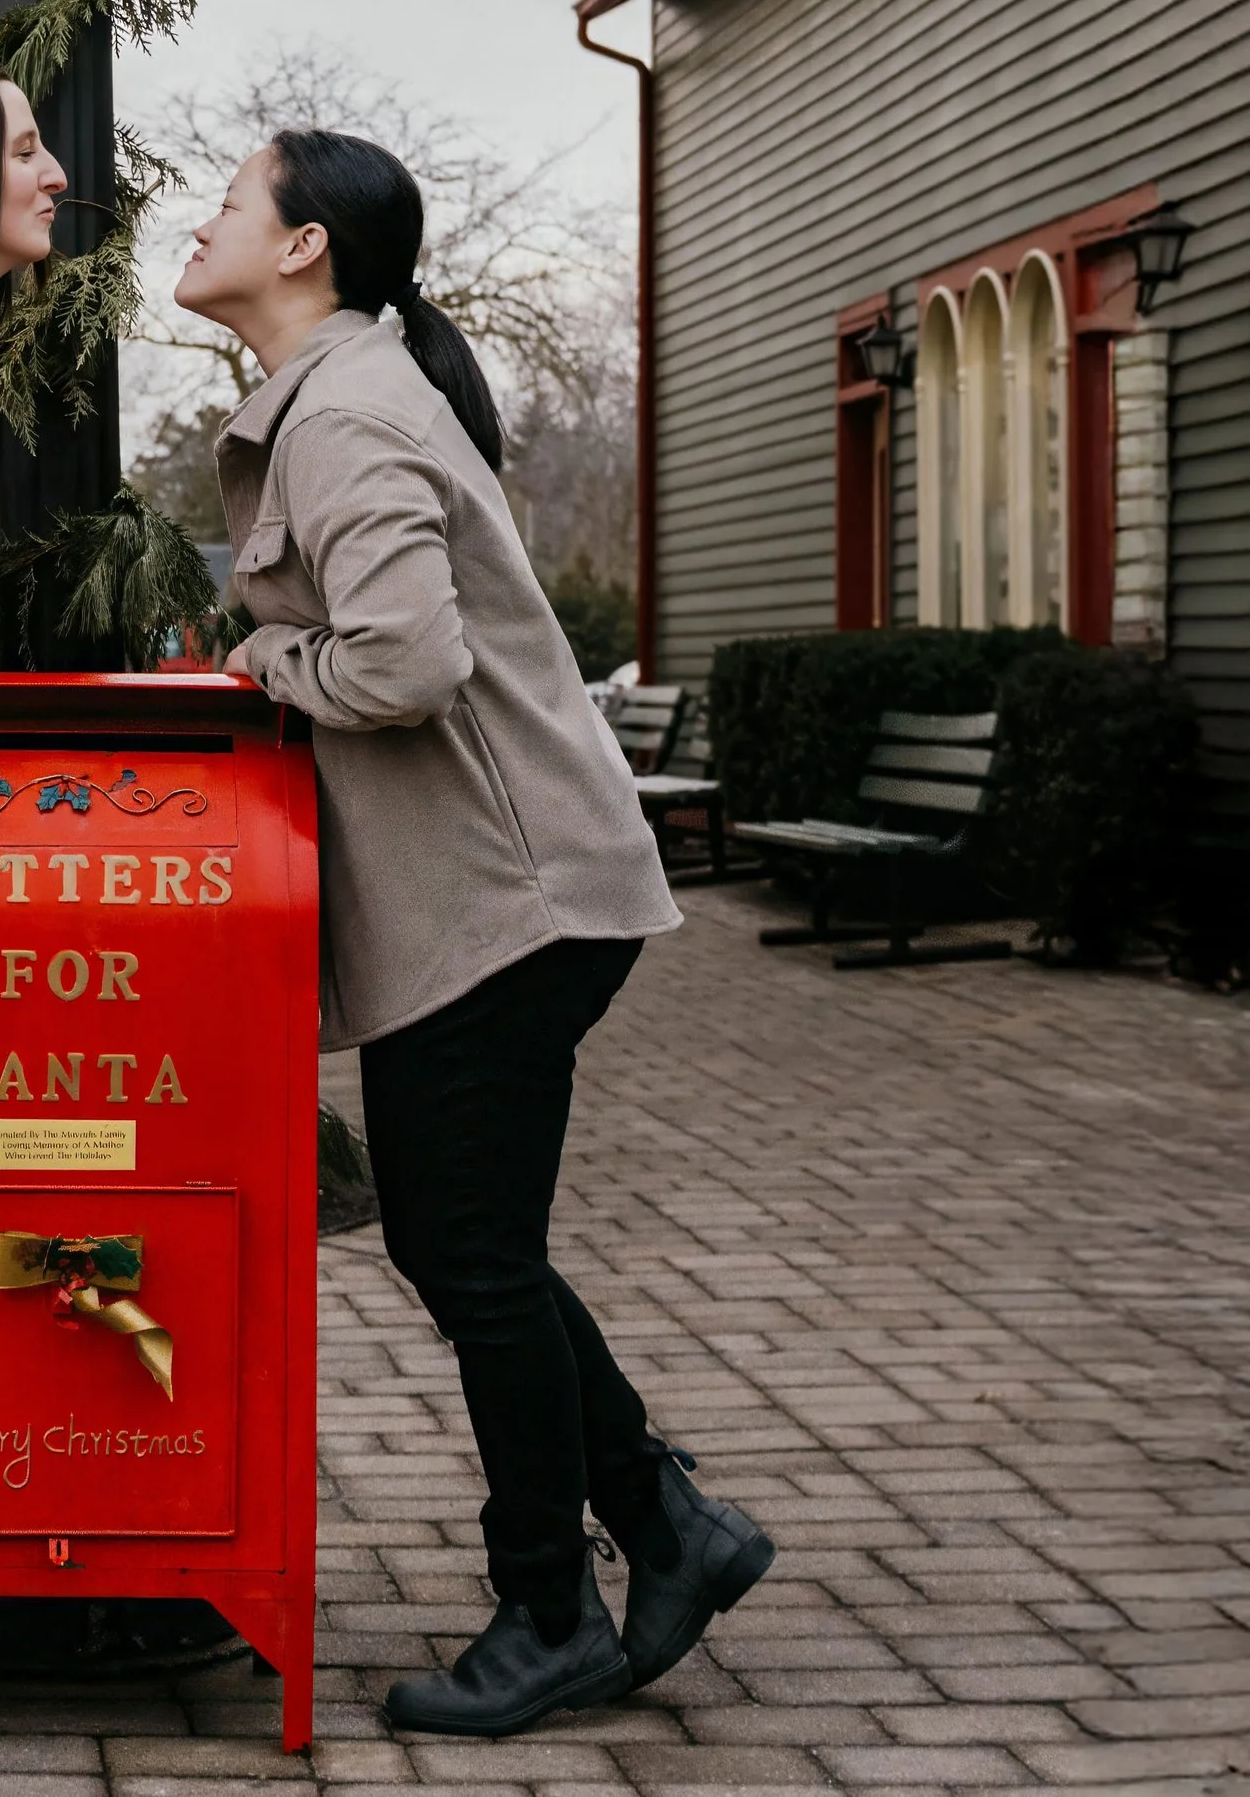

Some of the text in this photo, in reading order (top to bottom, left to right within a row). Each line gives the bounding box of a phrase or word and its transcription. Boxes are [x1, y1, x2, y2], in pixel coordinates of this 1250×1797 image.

[0, 949, 141, 1001] FOR
[29, 1130, 40, 1139] By
[43, 1130, 59, 1139] The
[99, 1130, 126, 1140] Family
[2, 1141, 31, 1150] Loving
[32, 1141, 69, 1150] Memory
[71, 1141, 81, 1149] of
[83, 1141, 91, 1149] A
[92, 1141, 125, 1149] Mother
[4, 1151, 112, 1160] Who Loved The Holidays
